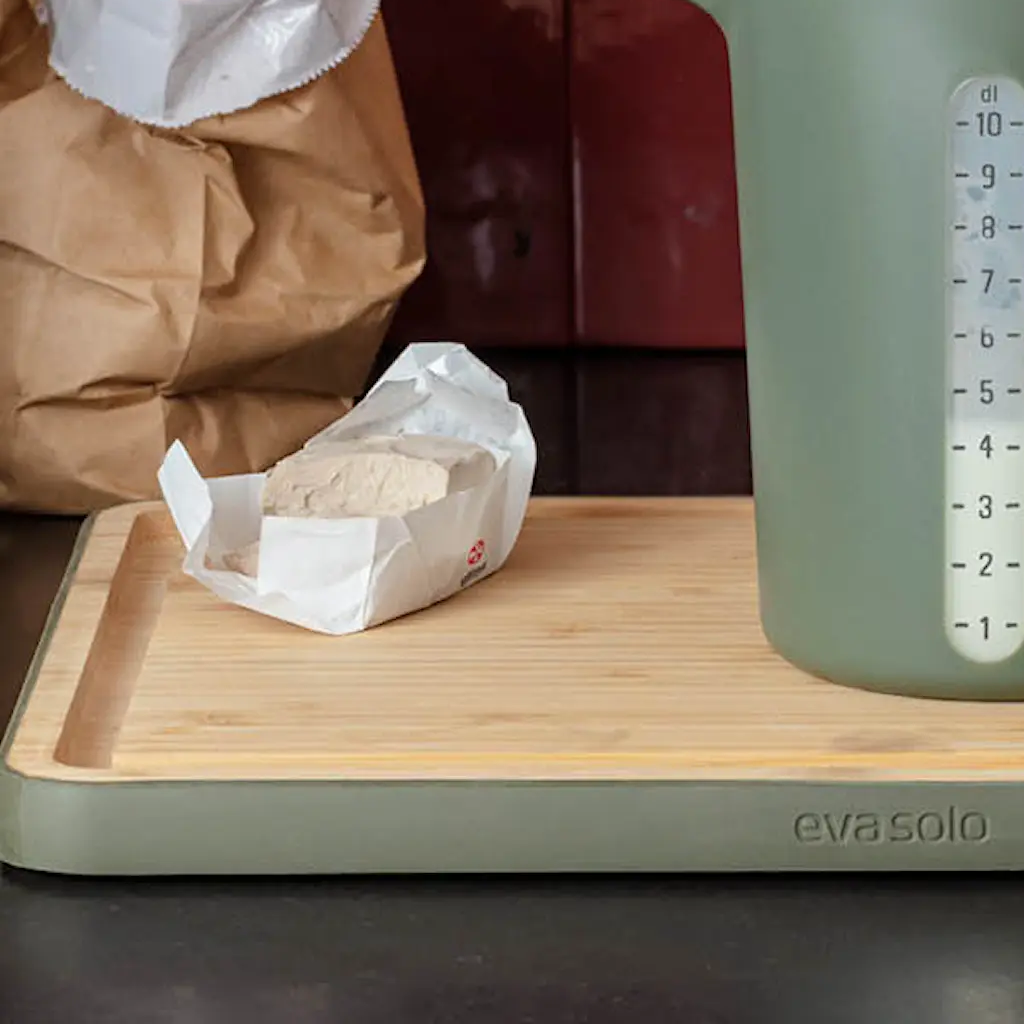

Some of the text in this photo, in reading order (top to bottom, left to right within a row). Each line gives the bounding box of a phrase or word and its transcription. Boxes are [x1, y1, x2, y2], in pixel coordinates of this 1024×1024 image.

[980, 85, 998, 103] dl
[976, 111, 1002, 137] 10
[981, 164, 996, 189] 9
[981, 215, 996, 239] 8
[980, 269, 995, 294] 7
[980, 325, 995, 349] 6
[979, 380, 995, 404] 5
[979, 434, 994, 459] 4
[978, 495, 993, 519] 3
[978, 552, 993, 577] 2
[979, 616, 990, 640] 1
